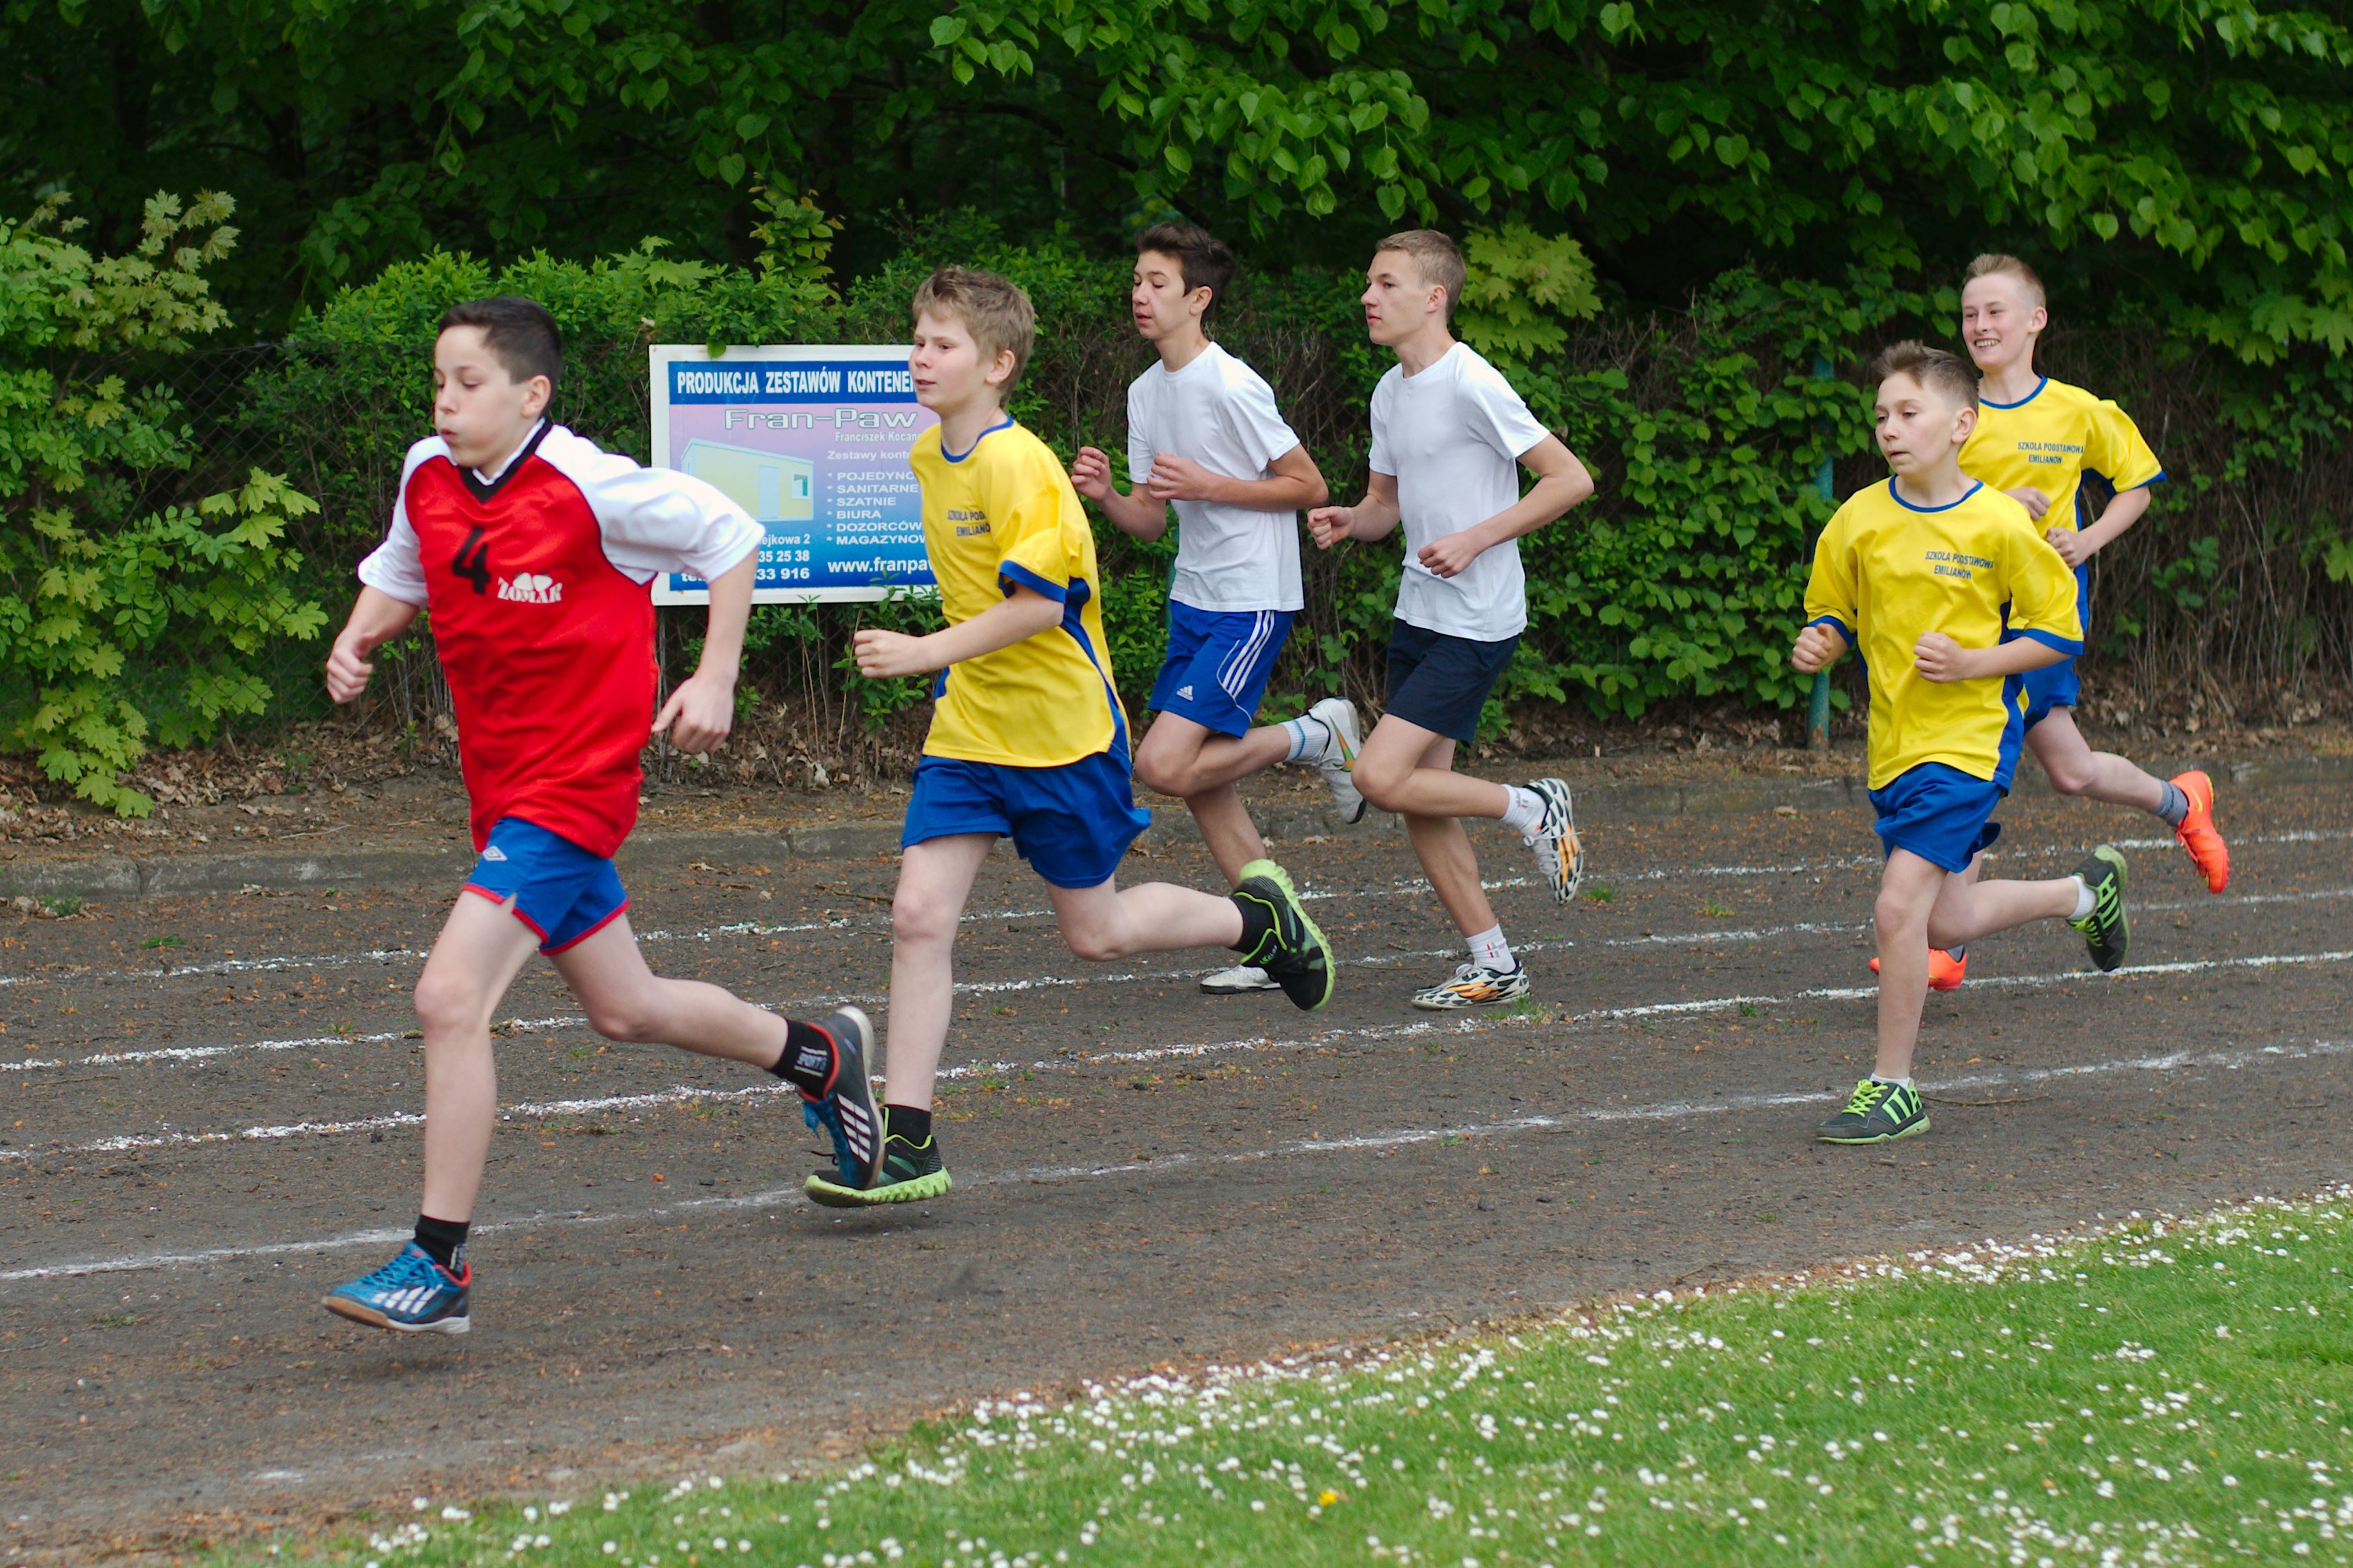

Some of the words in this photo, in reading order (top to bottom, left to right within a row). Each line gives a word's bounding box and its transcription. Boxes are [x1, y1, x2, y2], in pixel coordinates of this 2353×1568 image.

[677, 372, 759, 394] PRODUKCJA
[765, 366, 841, 393] ZESTAWÓW
[725, 408, 918, 430] Fran-Paw
[835, 431, 885, 441] Franciszek
[827, 450, 877, 461] Zestawy
[836, 484, 919, 494] SANITARNE
[836, 496, 897, 507] SZATNIE
[836, 510, 882, 519] BIURA
[836, 520, 923, 532] DOZORCÓW
[759, 534, 800, 547] ejkowa
[802, 533, 811, 544] 2
[453, 528, 490, 595] 4
[776, 550, 791, 562] 25
[794, 550, 809, 561] 38
[754, 568, 776, 580] 33
[780, 567, 810, 579] 916
